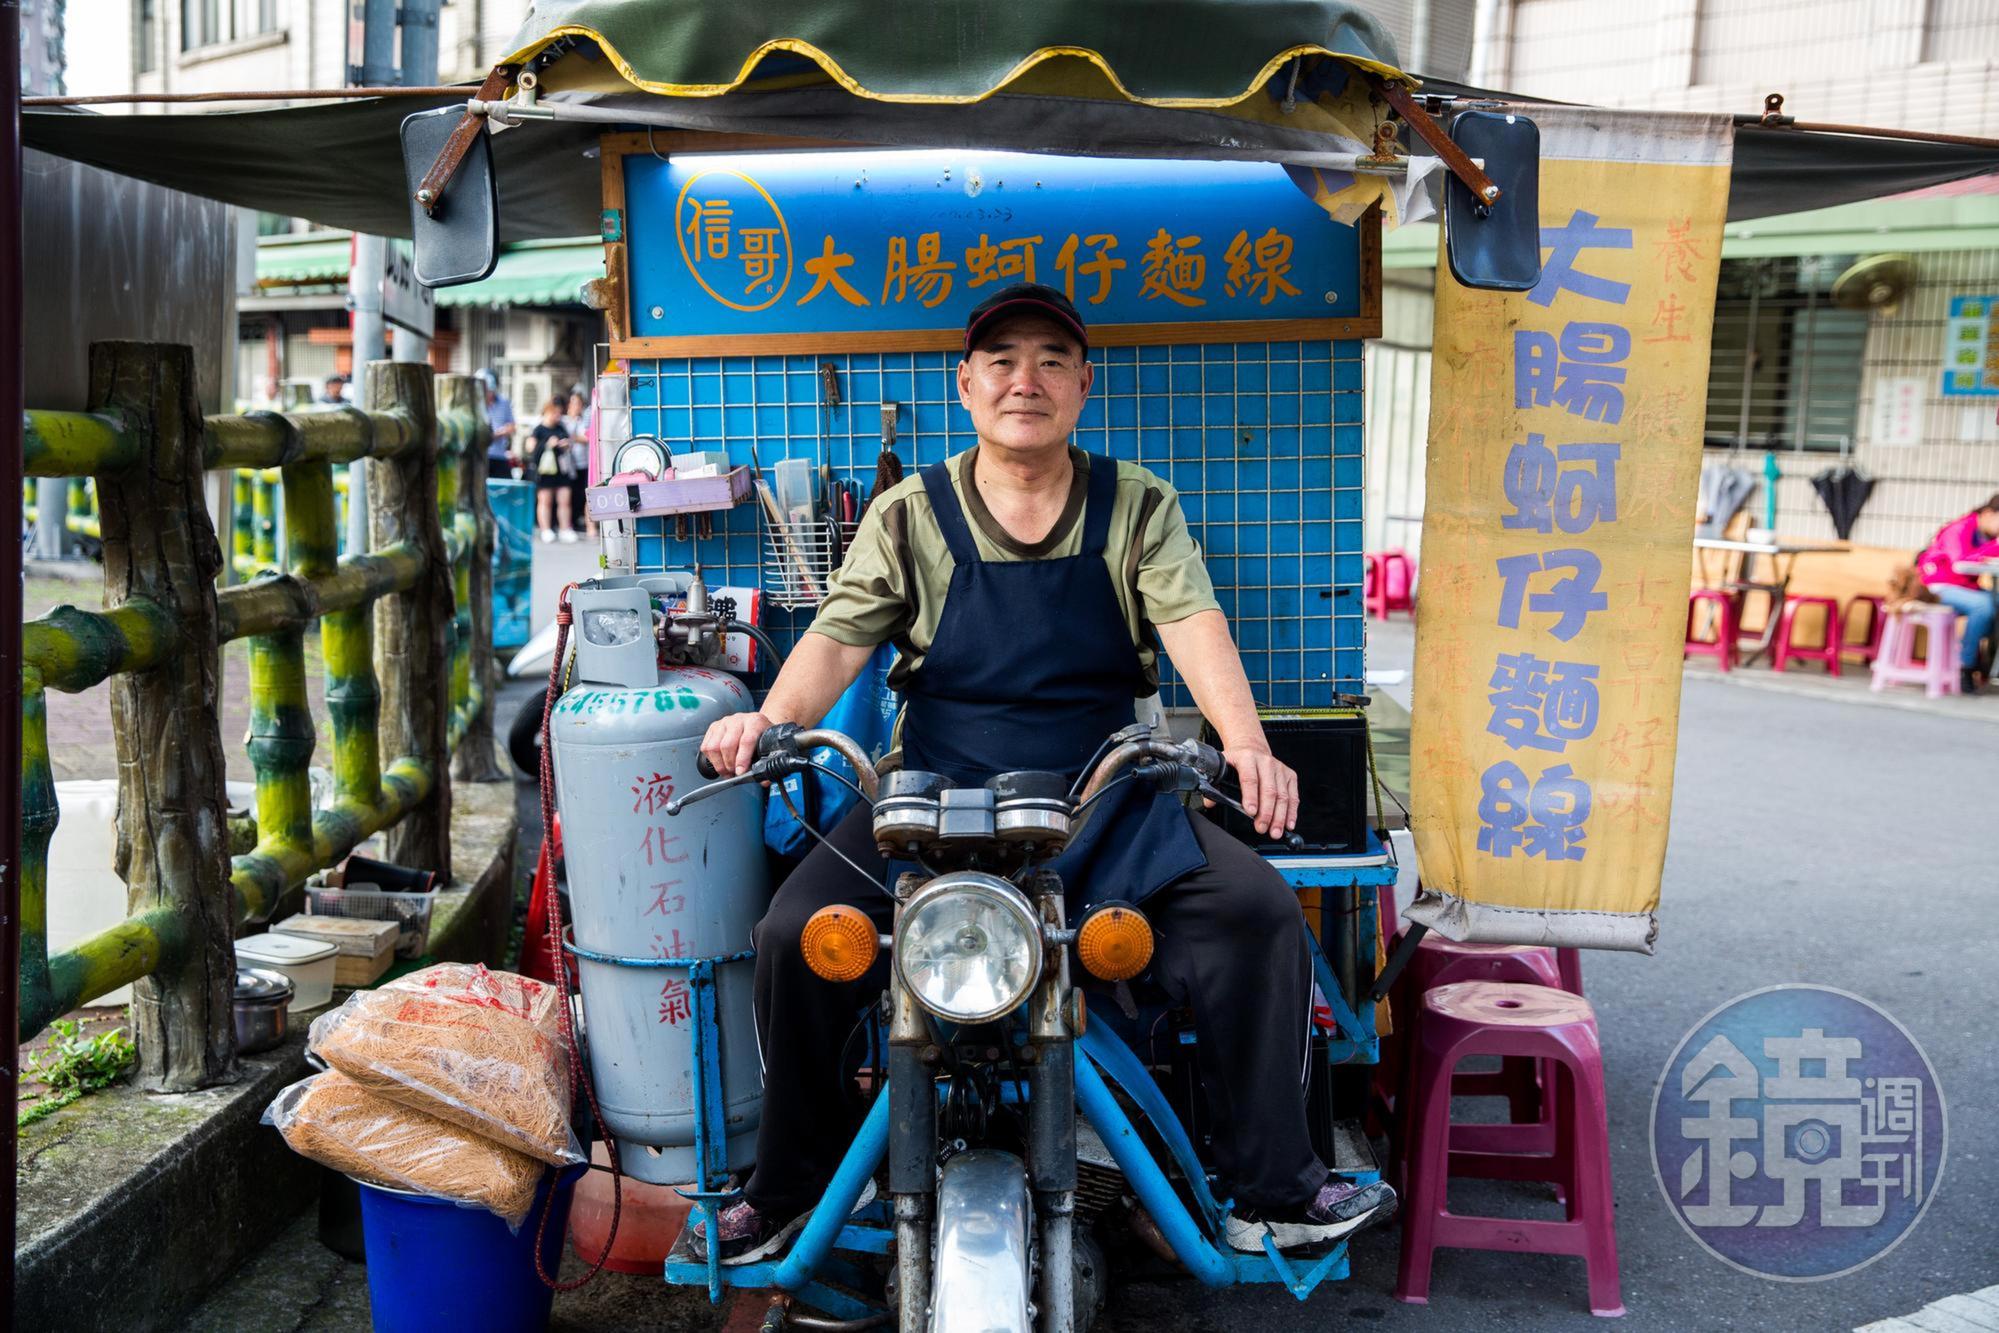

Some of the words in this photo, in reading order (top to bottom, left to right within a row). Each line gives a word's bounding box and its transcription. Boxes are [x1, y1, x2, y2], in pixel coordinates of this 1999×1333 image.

[686, 197, 781, 295] 信哥
[796, 226, 1302, 308] 大腸蚵仔麵線
[1477, 208, 1633, 862] 大腸蚵仔麵線
[631, 772, 697, 1025] 液化石油氣
